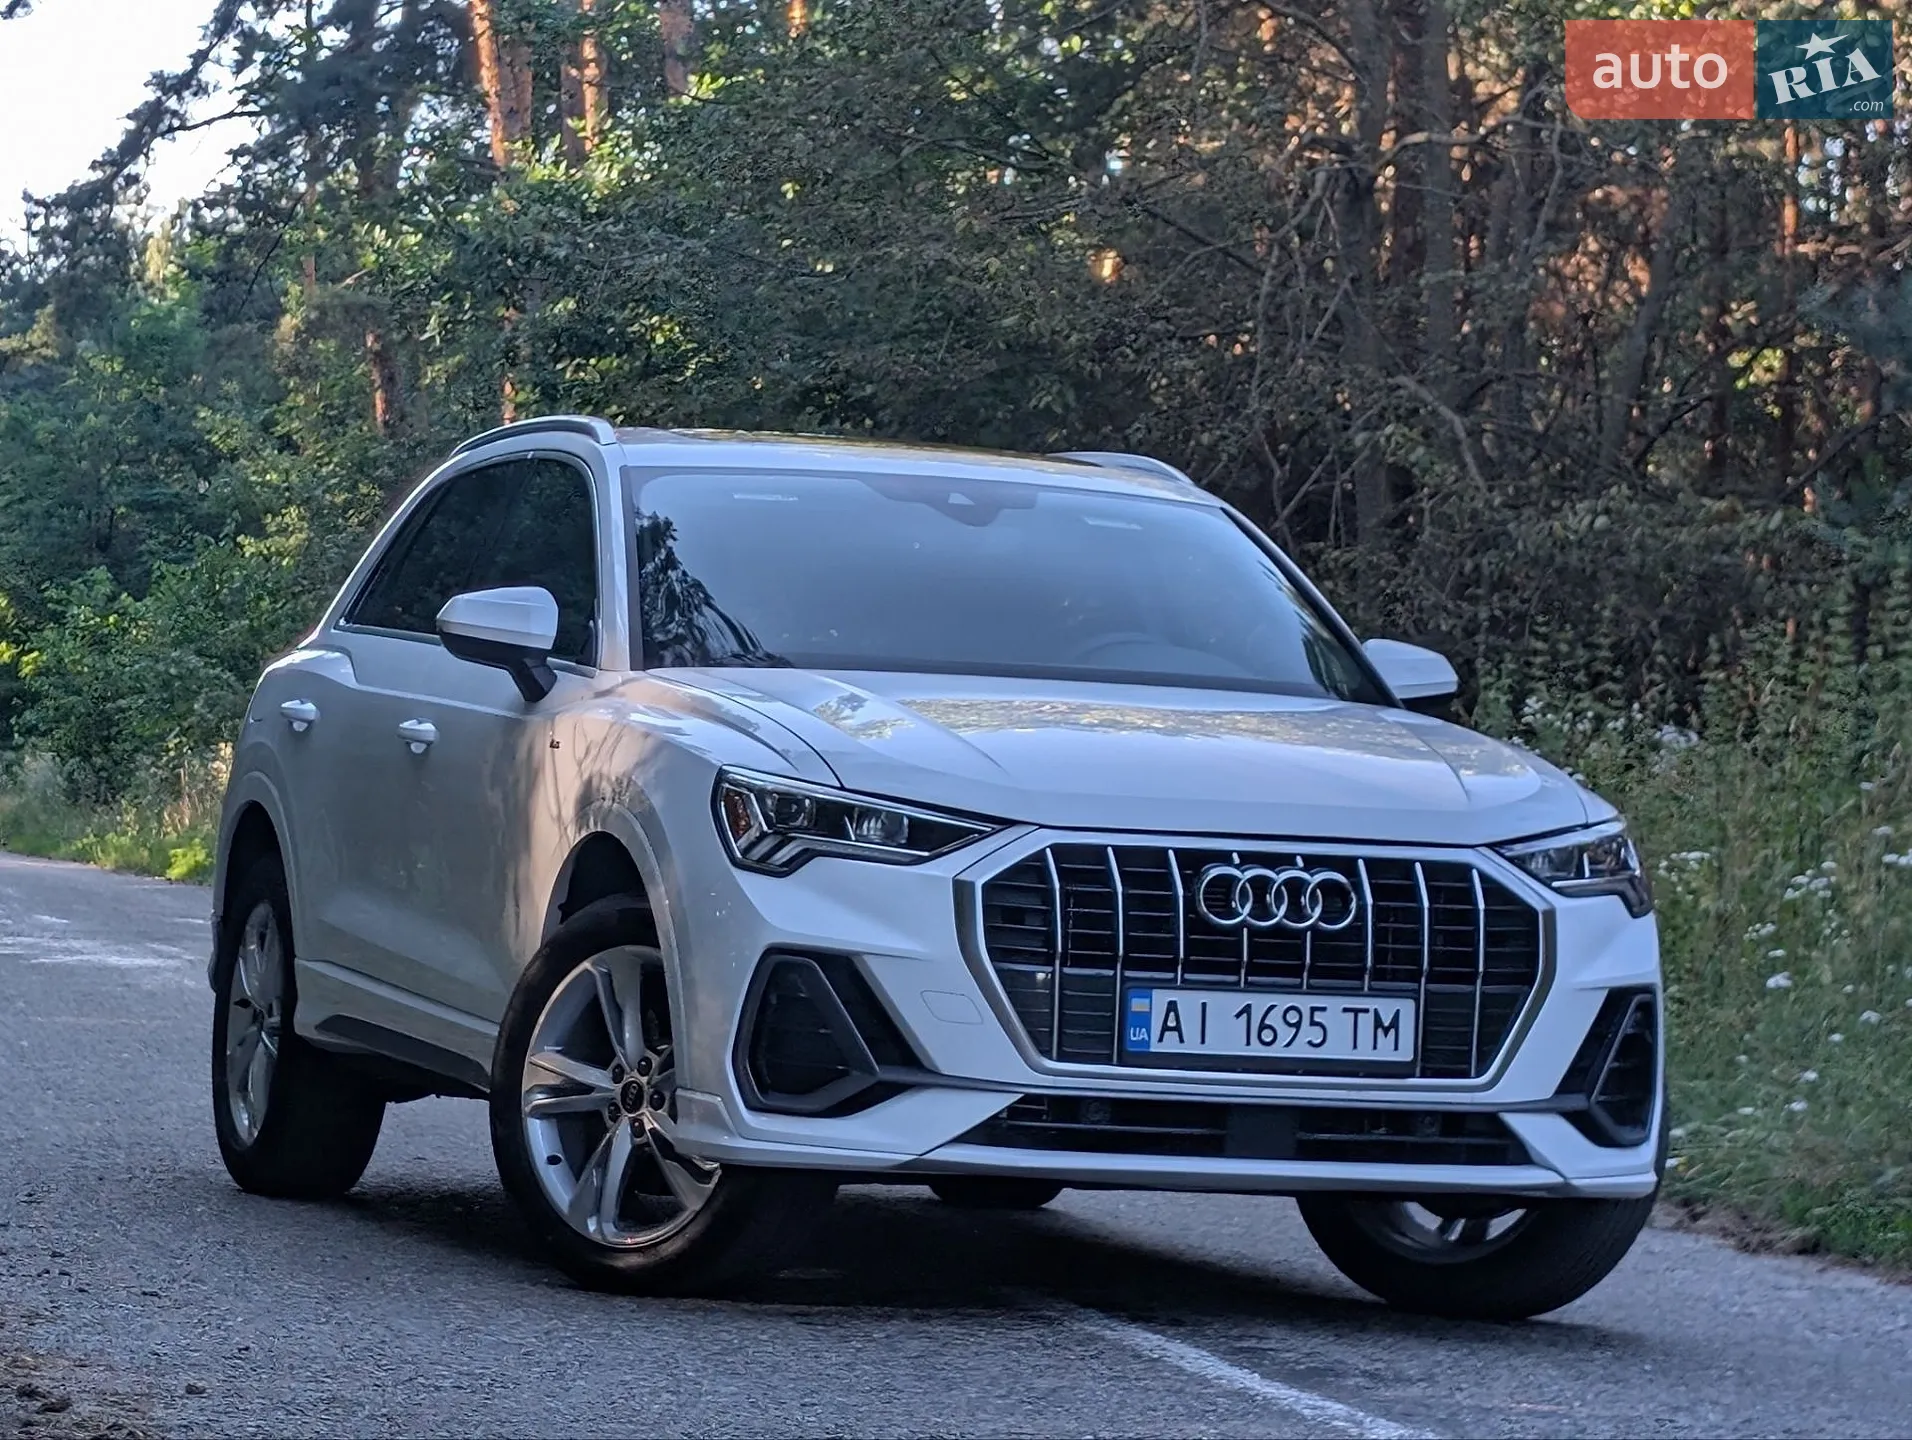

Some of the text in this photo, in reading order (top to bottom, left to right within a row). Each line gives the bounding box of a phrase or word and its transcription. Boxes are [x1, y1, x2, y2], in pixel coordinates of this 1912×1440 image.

[1130, 1027, 1148, 1041] UA
[1157, 1000, 1401, 1051] AI 1695 TM
